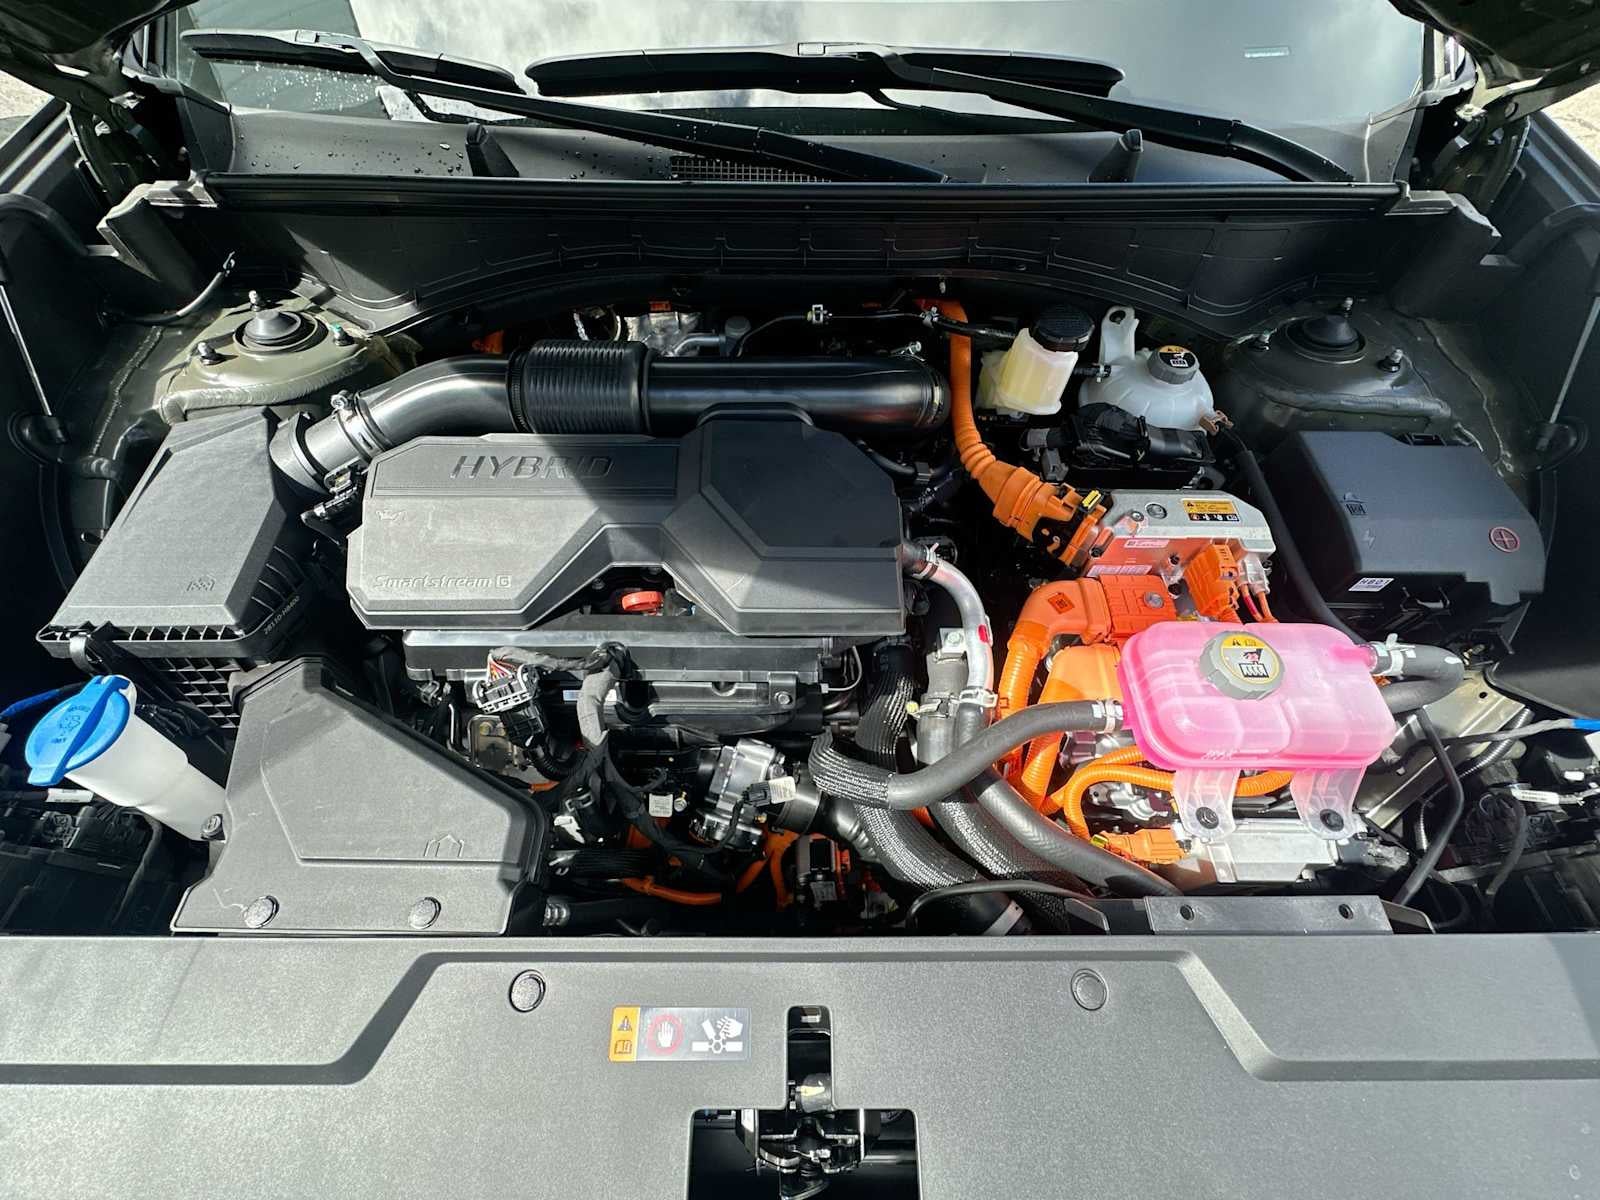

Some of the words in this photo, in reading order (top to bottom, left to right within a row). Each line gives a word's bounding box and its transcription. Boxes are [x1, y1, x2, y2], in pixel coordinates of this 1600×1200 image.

[450, 455, 615, 480] HYBRID
[374, 574, 493, 589] Smartstream
[496, 574, 512, 589] G
